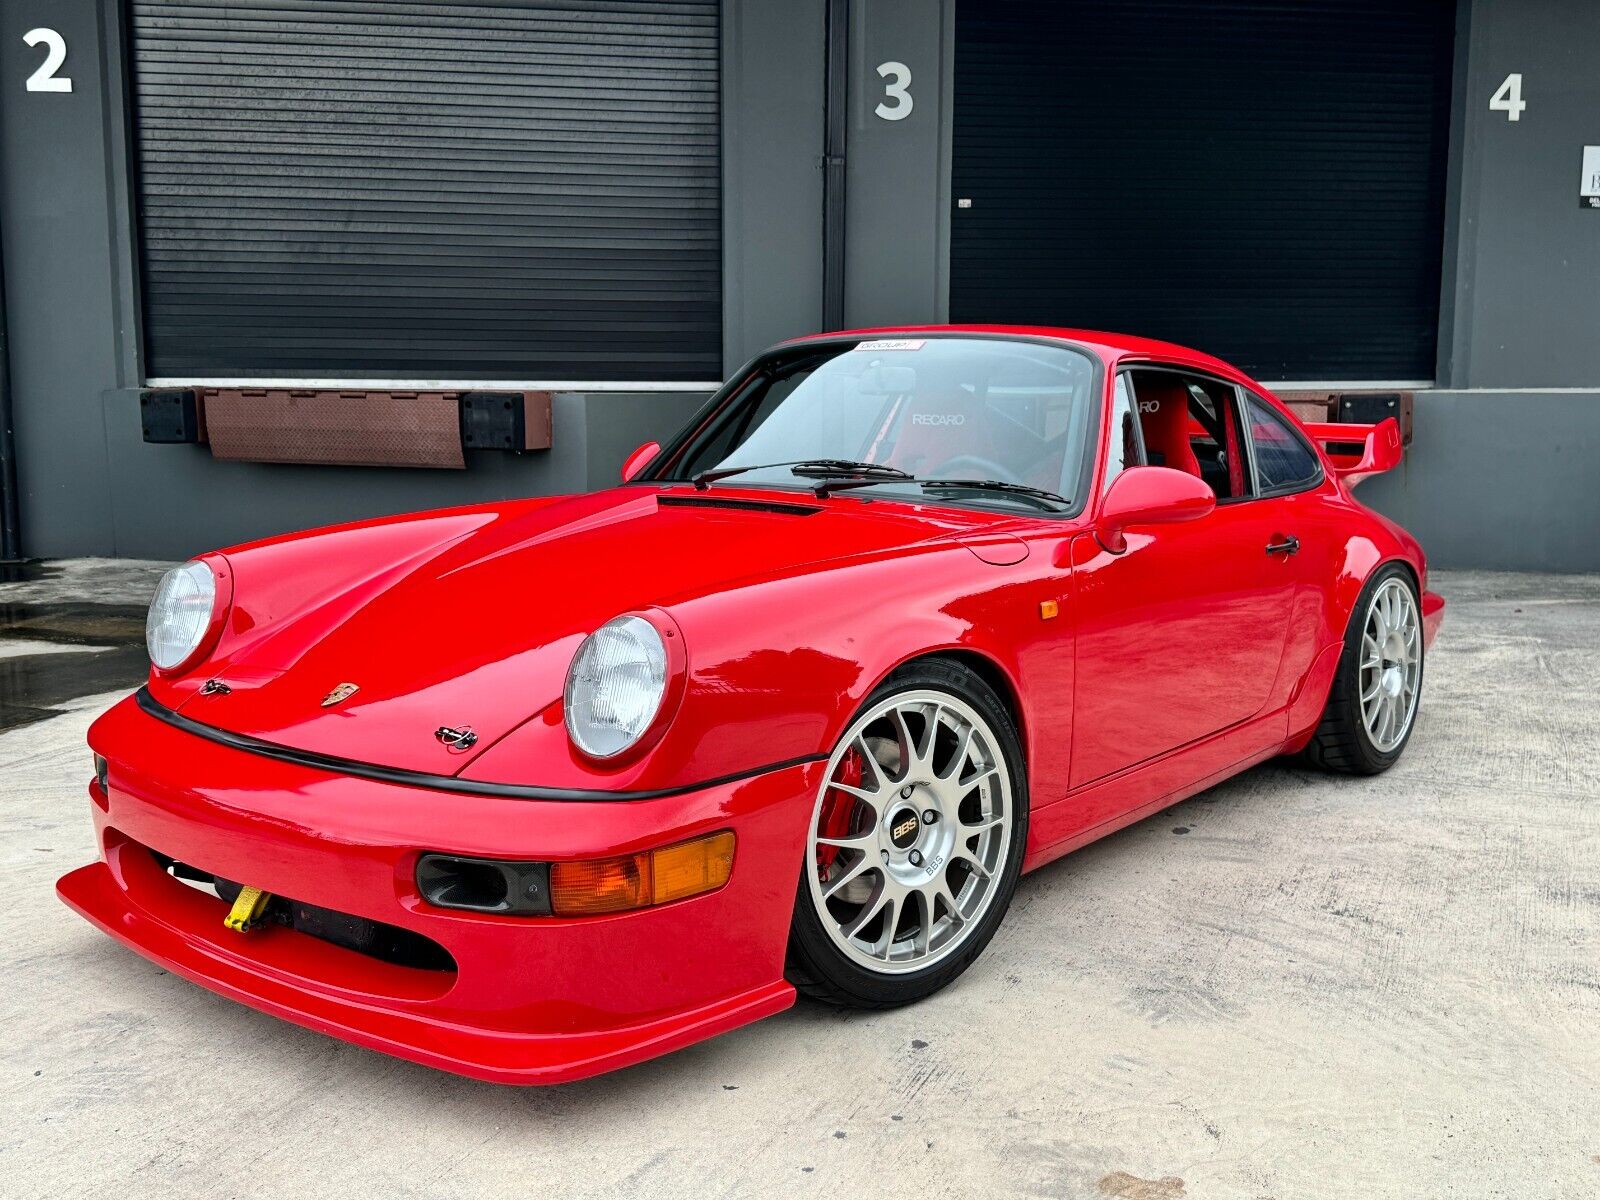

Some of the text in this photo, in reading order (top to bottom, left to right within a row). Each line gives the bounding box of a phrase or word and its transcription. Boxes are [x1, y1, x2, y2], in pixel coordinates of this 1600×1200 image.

[22, 27, 73, 93] 2
[874, 61, 914, 121] 3
[1489, 73, 1526, 121] 4
[912, 414, 965, 426] RECARO
[893, 816, 916, 840] BBS
[925, 855, 944, 876] BBS
